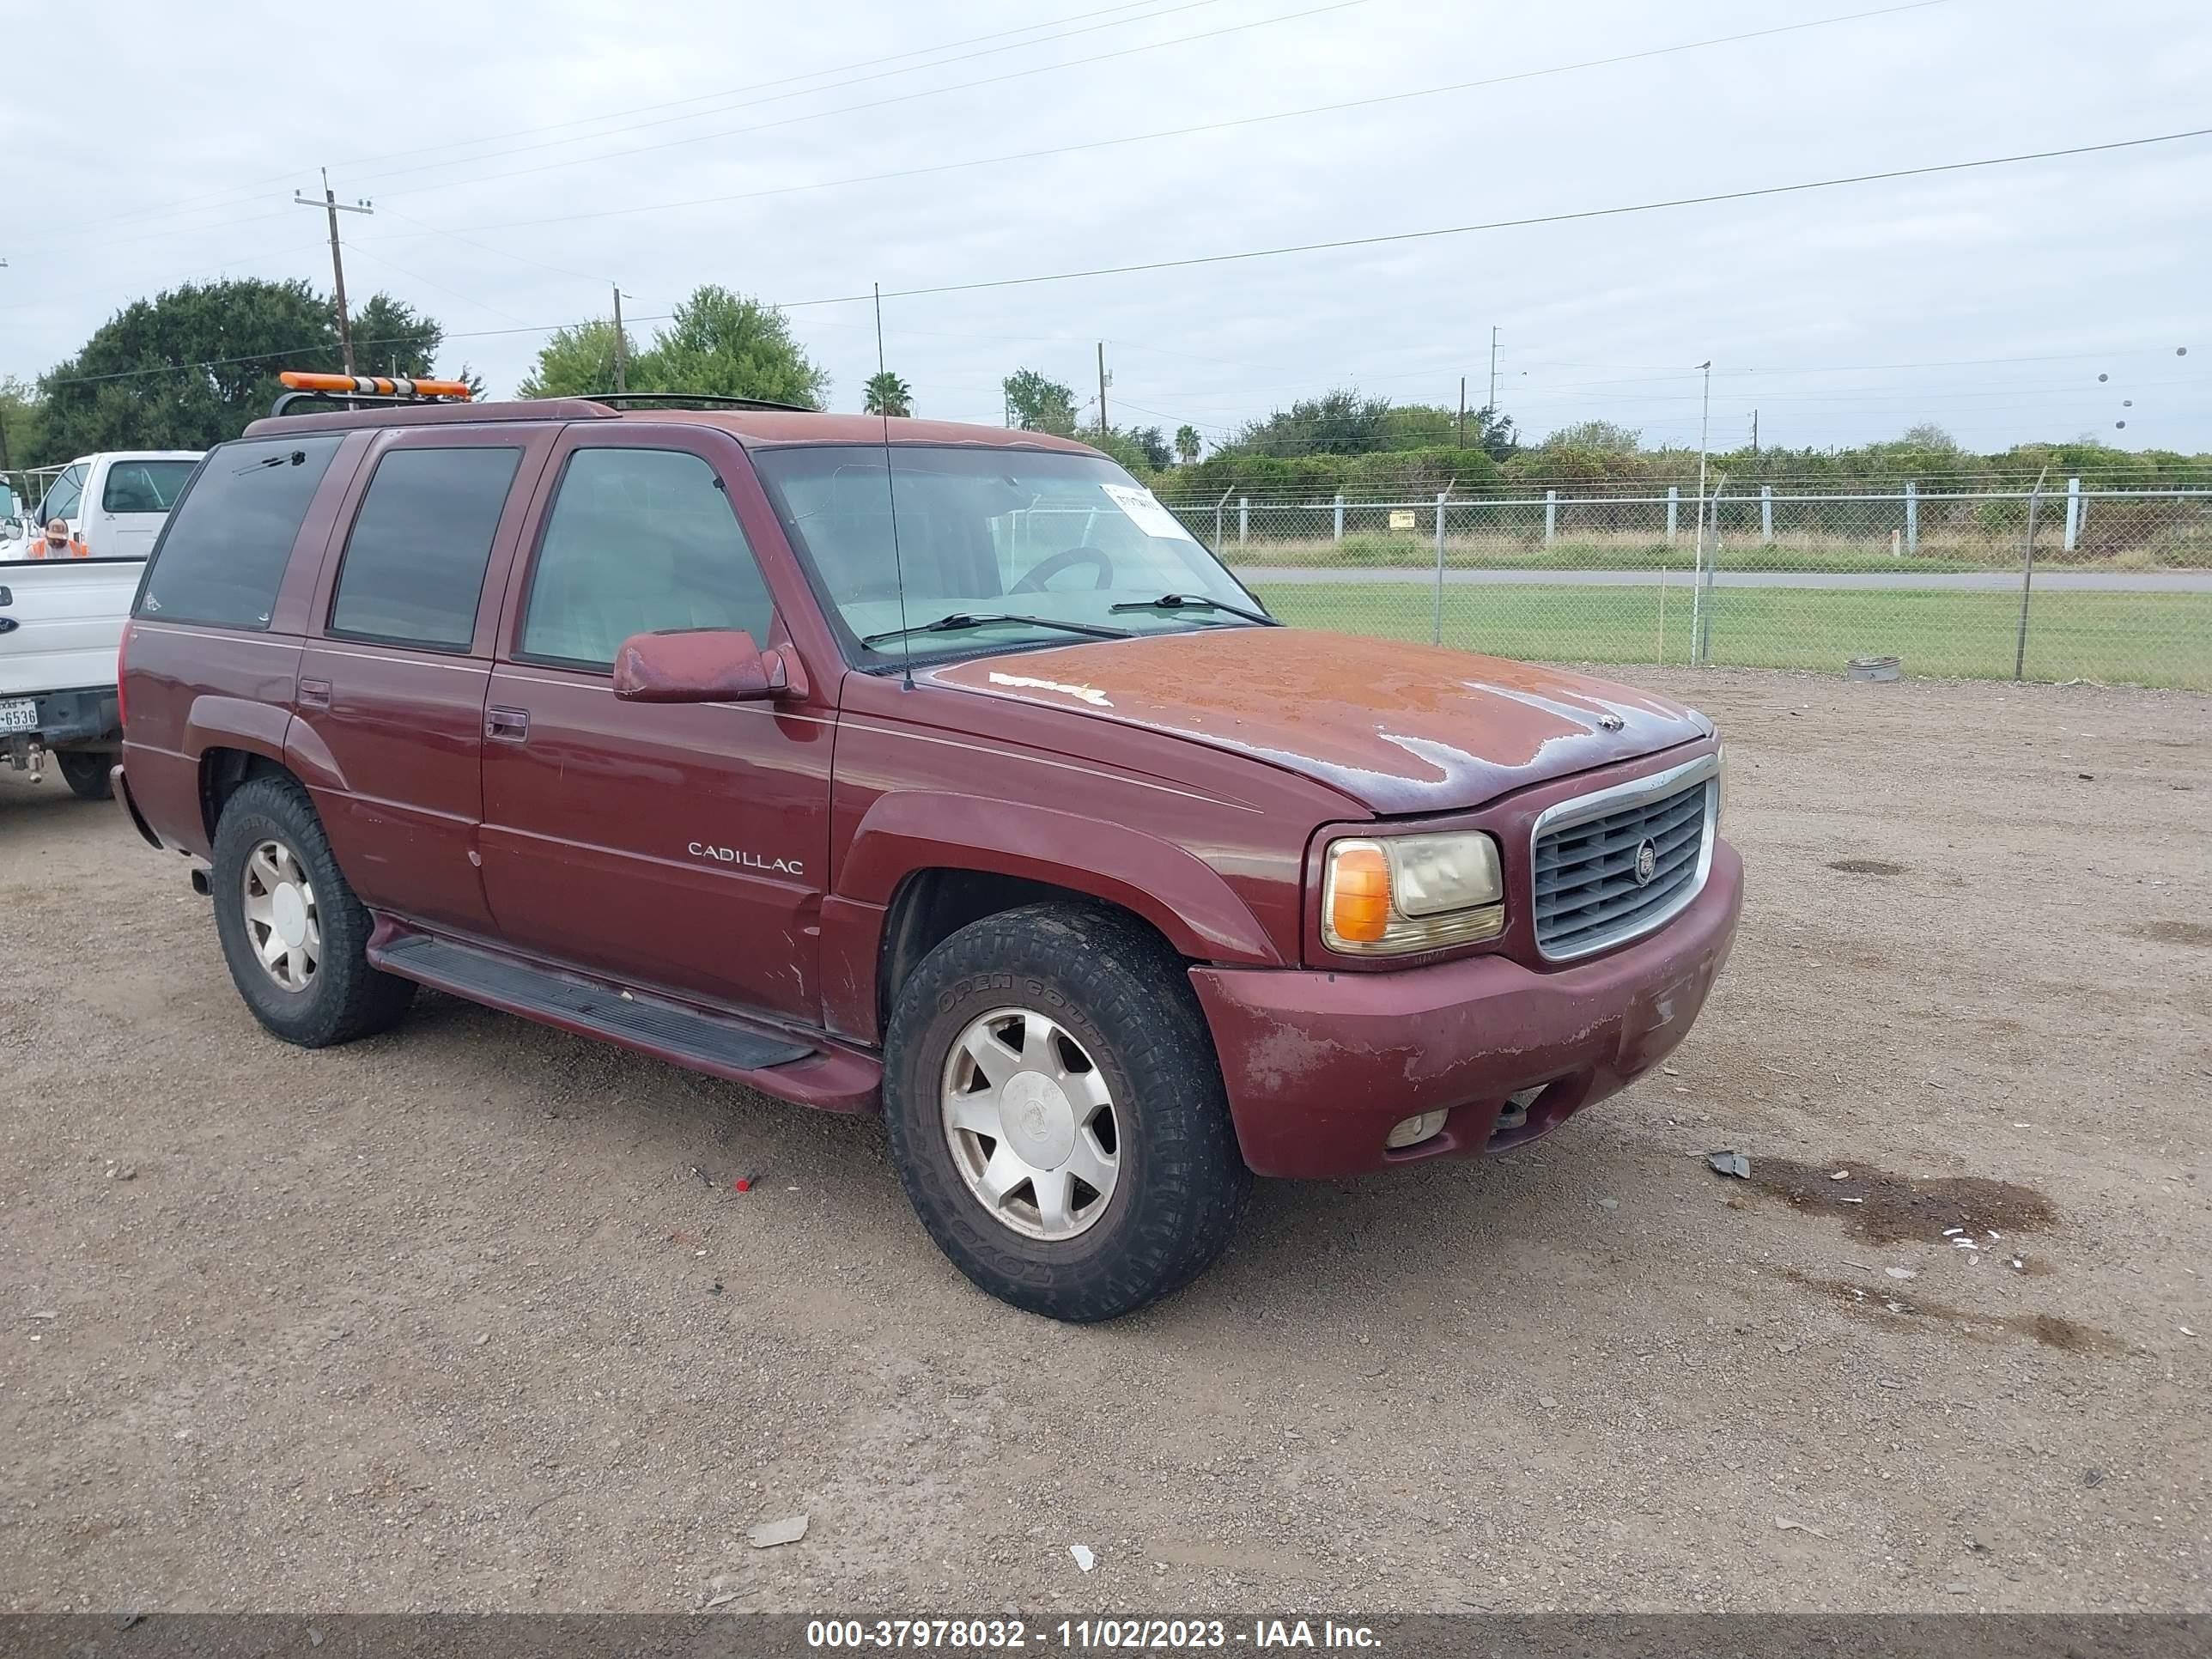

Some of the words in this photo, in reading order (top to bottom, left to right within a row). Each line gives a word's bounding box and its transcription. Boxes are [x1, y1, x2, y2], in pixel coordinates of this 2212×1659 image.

[688, 842, 804, 875] CADILLAC
[939, 973, 1012, 1013] OPEN
[951, 1220, 1053, 1285] TOYO
